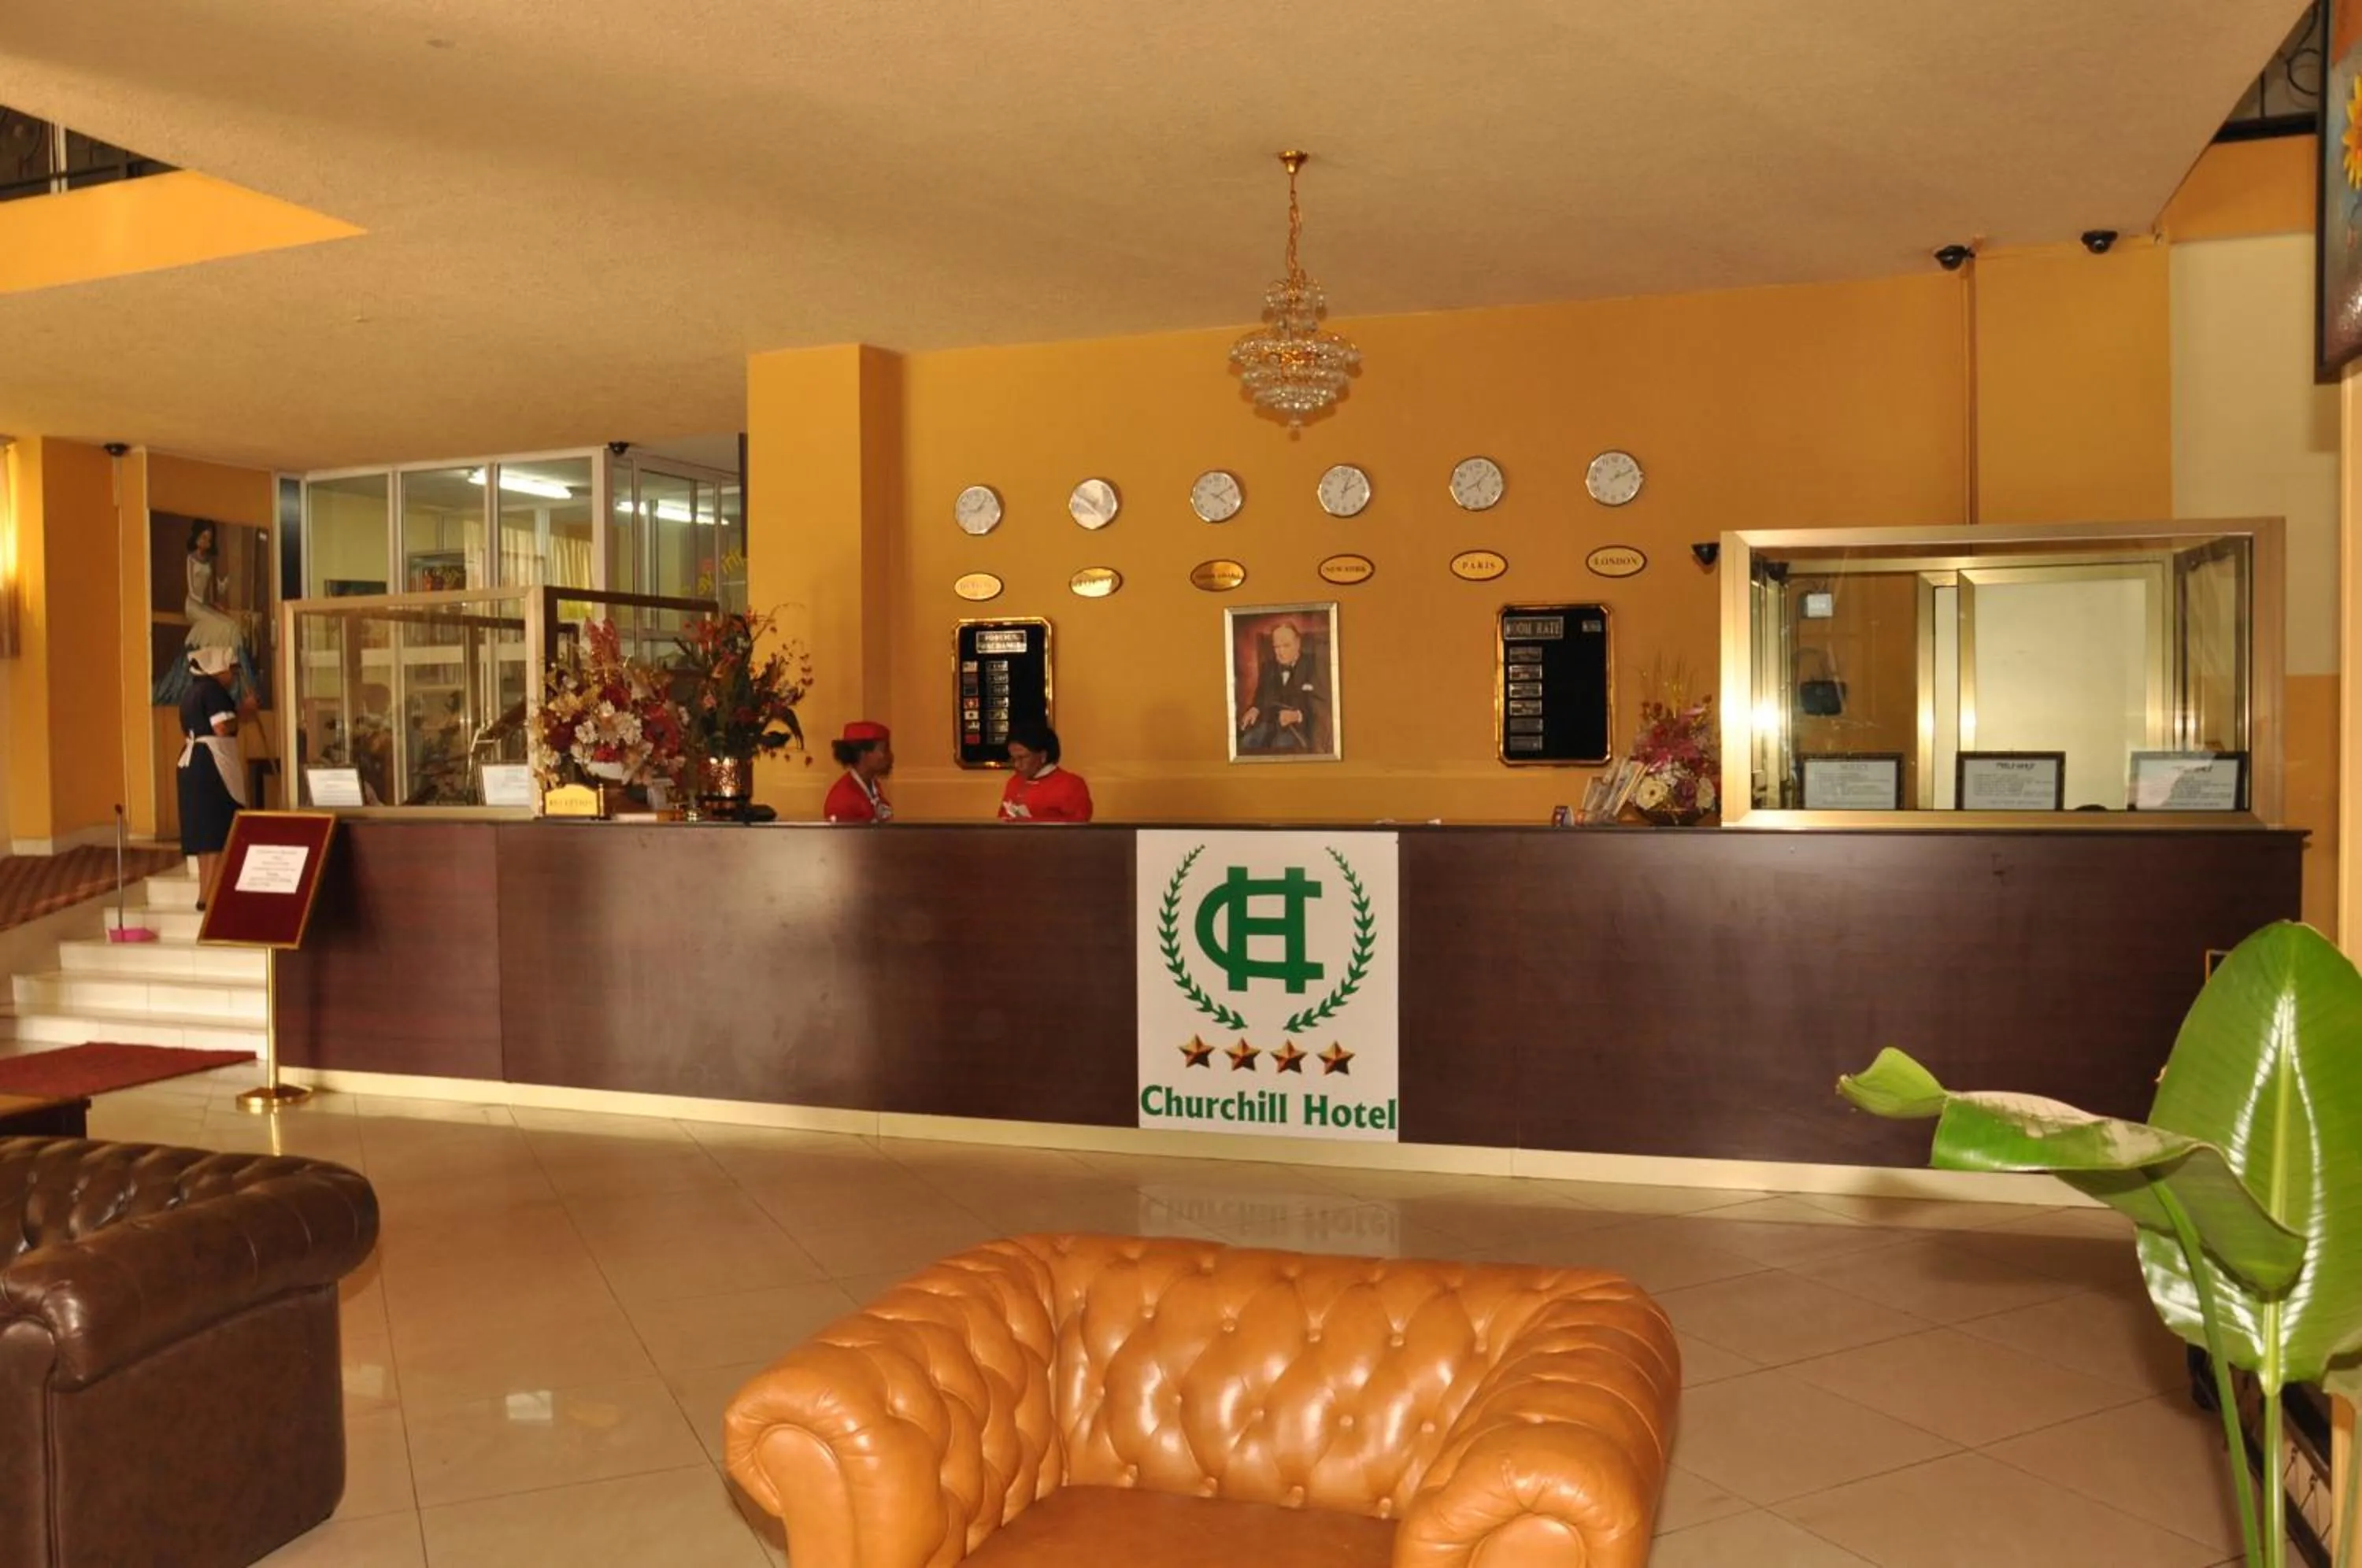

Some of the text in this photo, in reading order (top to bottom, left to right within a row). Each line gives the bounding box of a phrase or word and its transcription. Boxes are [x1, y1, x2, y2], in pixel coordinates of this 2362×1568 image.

[1462, 561, 1495, 571] PARIS
[1593, 556, 1639, 567] LONDON
[1141, 1085, 1398, 1130] Churchill Hotel
